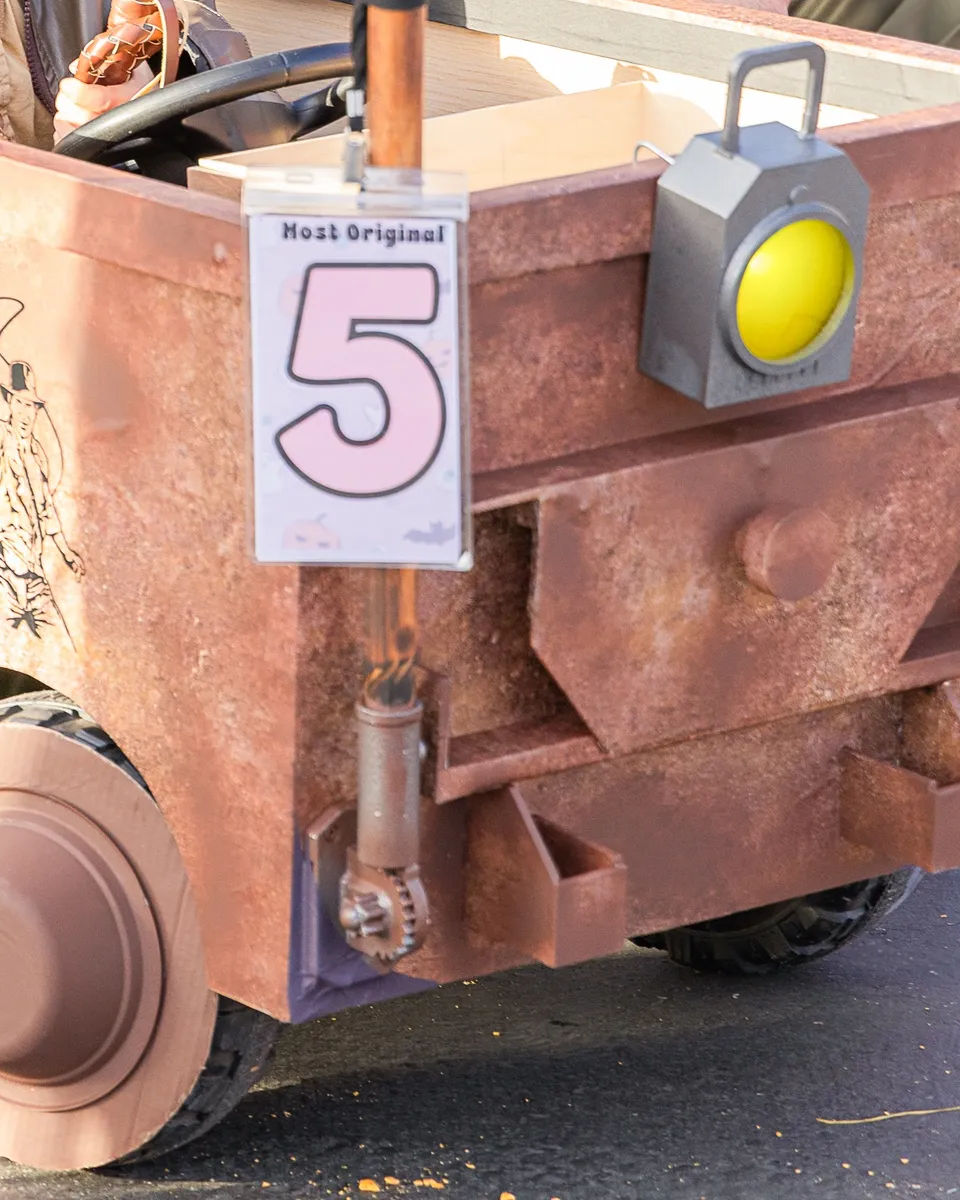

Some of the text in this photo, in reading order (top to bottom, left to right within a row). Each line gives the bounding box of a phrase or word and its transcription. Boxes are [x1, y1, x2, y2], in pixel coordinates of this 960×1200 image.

[283, 218, 445, 247] Most Original
[275, 262, 447, 499] 5
